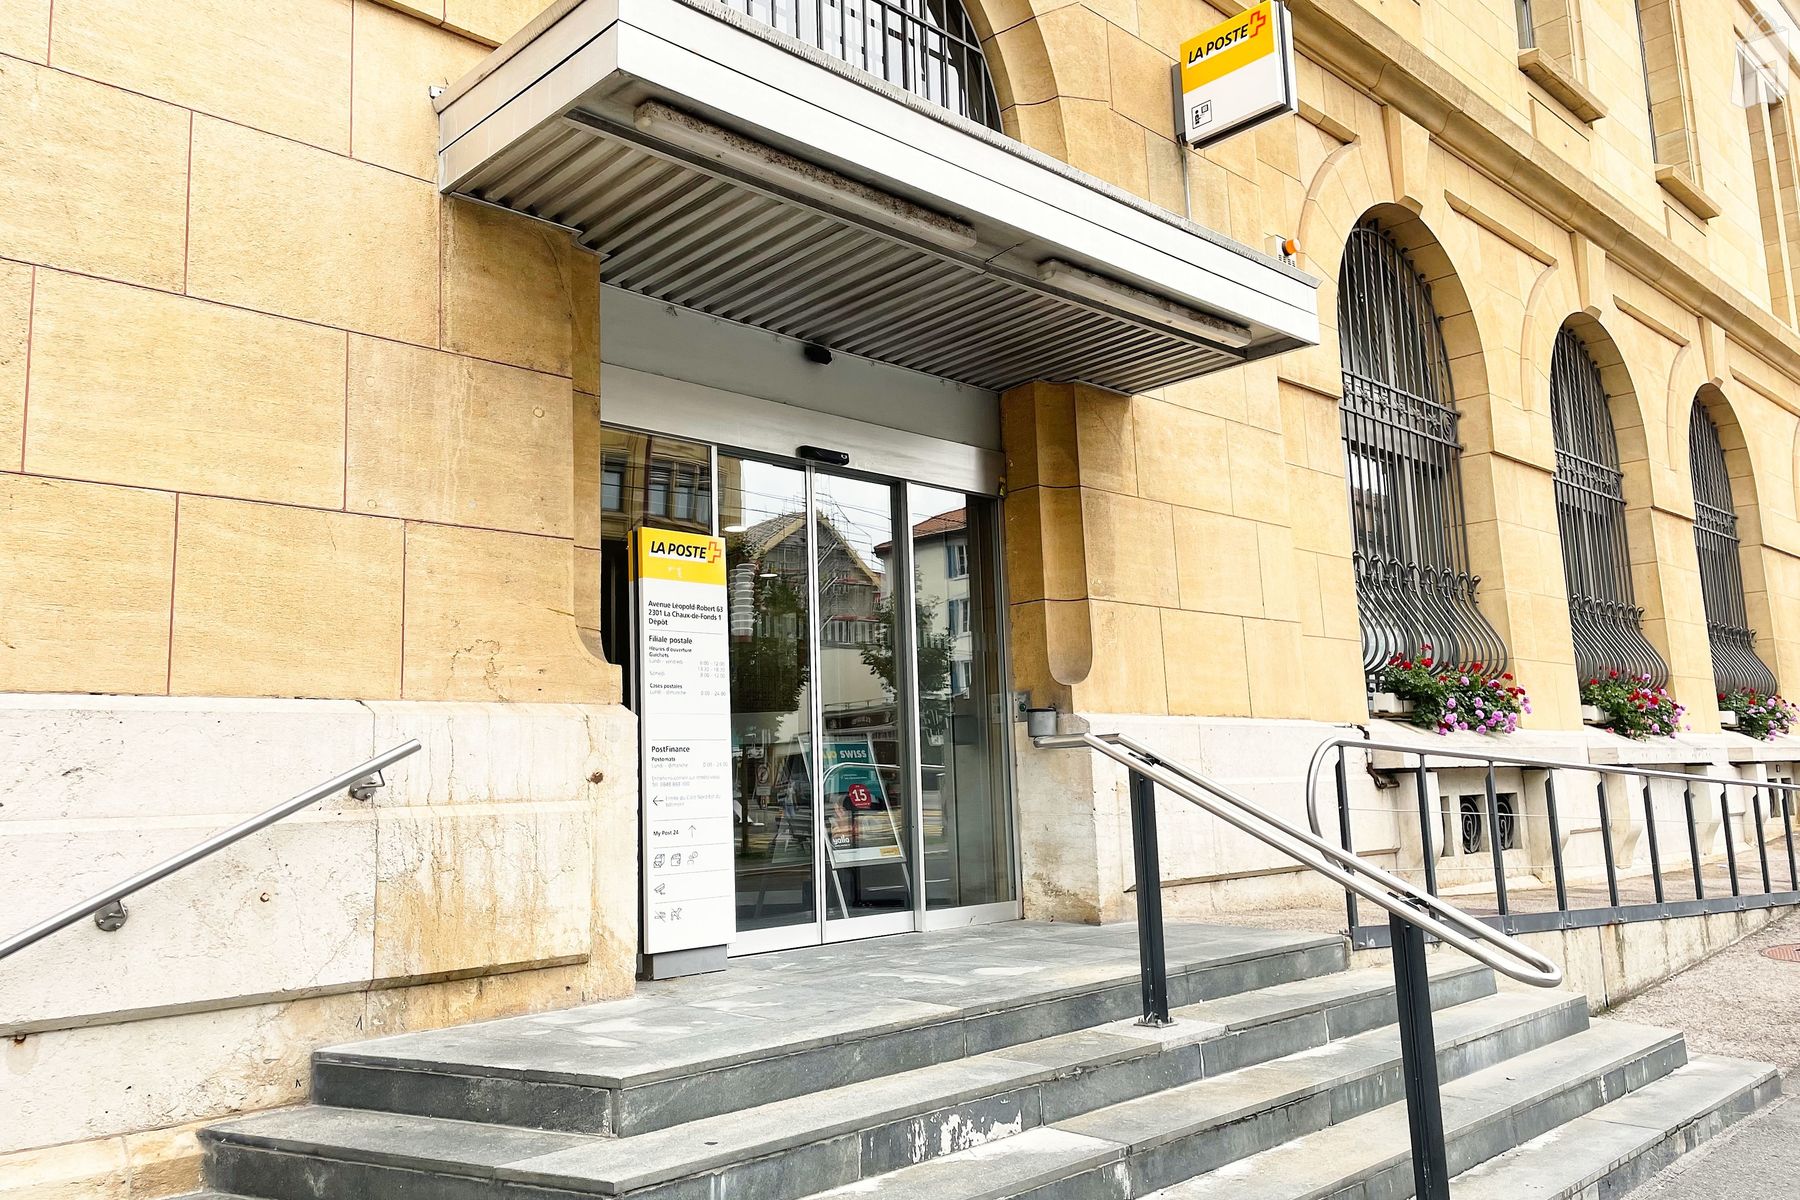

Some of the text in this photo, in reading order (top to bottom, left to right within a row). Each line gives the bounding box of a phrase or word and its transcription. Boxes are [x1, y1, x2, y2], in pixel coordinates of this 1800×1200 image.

[1188, 23, 1249, 64] LA POSTE
[651, 541, 707, 559] LA POSTE
[648, 600, 671, 608] Avenue
[672, 610, 718, 620] Chaux-de-Fonds
[648, 634, 668, 643] Filiale
[840, 749, 867, 759] SWISS
[852, 788, 868, 802] 15
